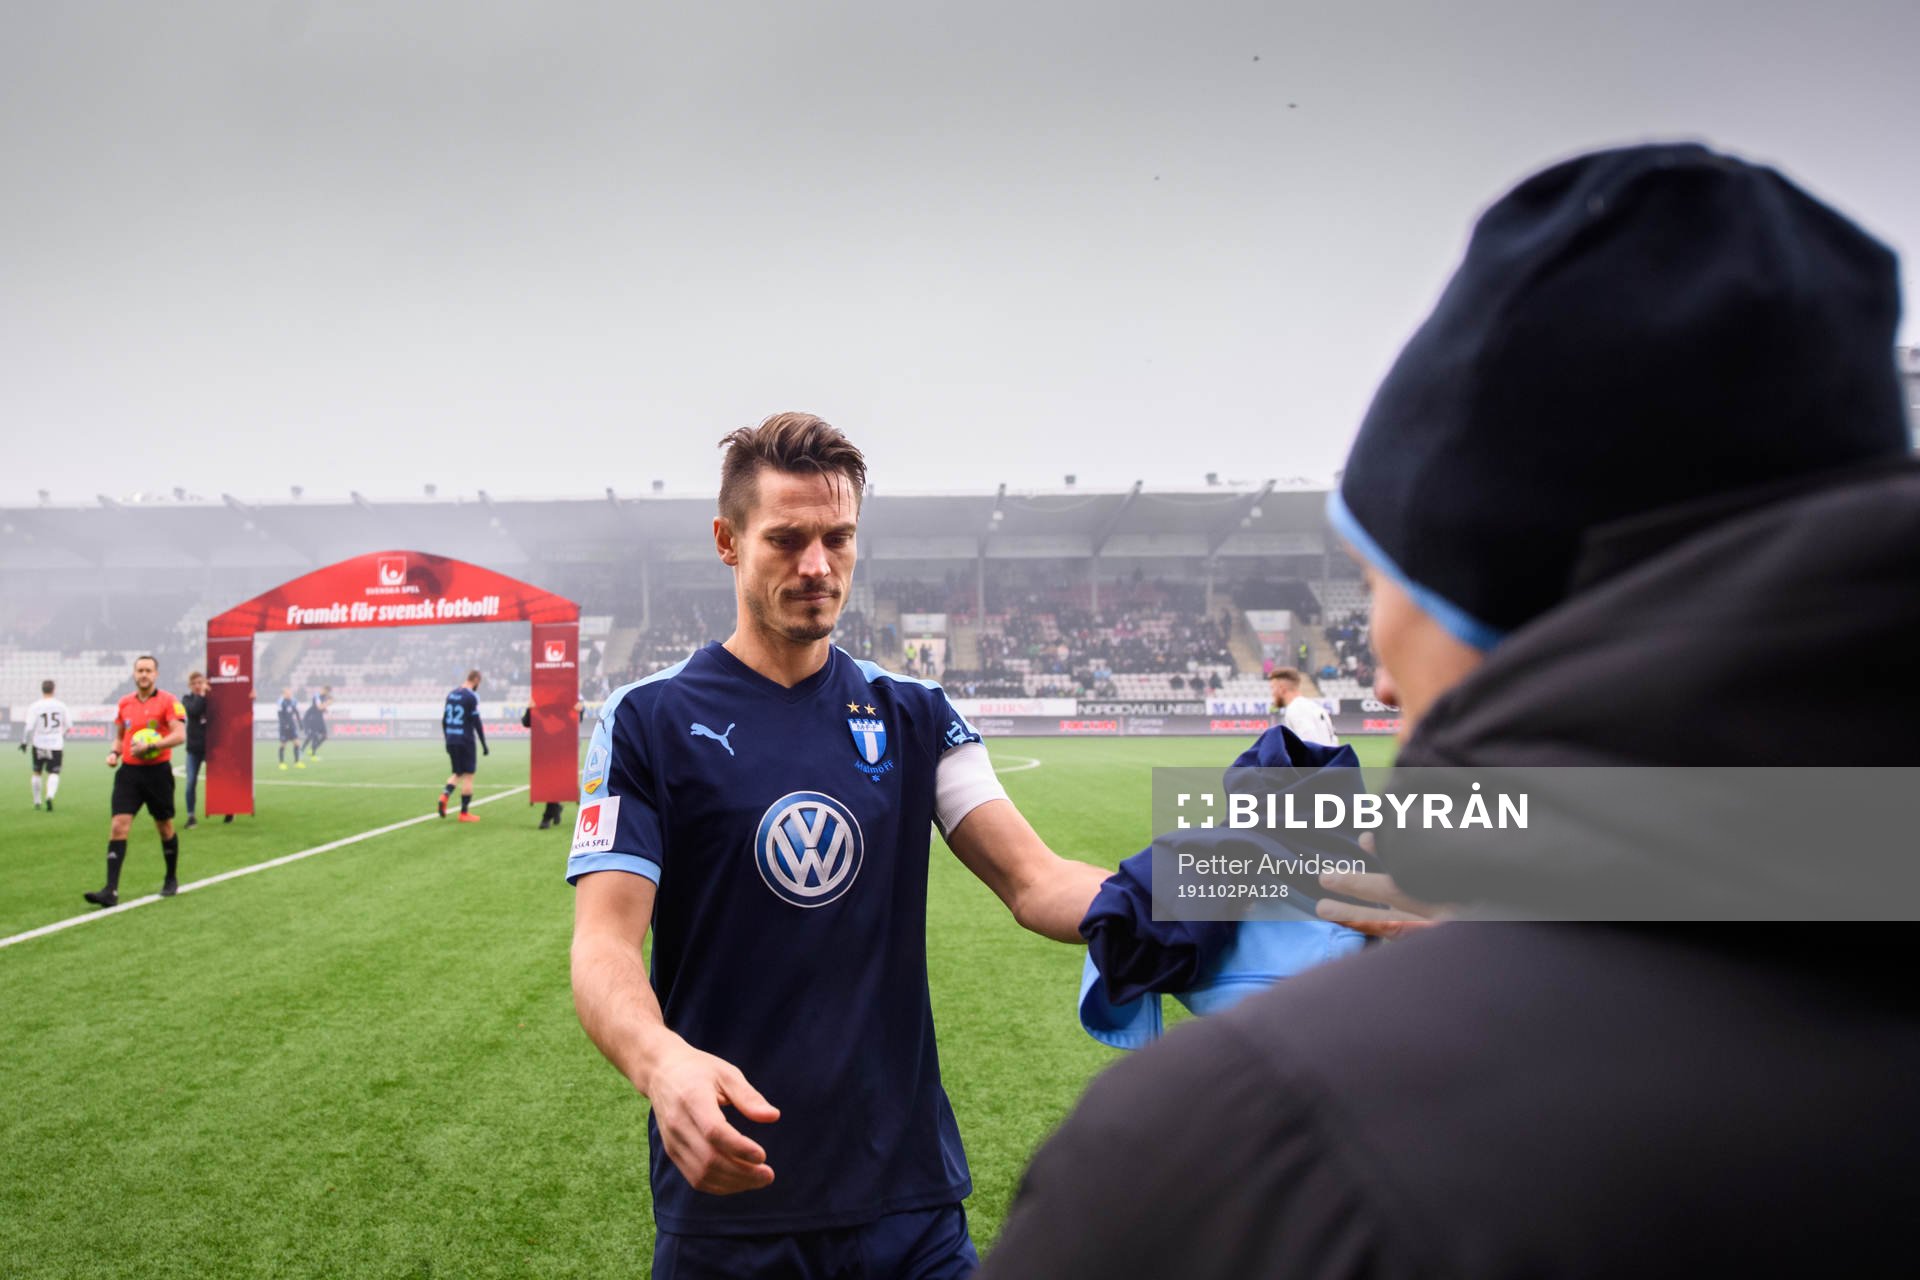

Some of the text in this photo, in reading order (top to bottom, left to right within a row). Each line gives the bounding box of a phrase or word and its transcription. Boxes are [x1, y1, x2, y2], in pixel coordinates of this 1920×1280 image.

[287, 596, 500, 625] Framåt för svensk fotboll!
[40, 712, 61, 728] 15
[446, 704, 465, 725] 32
[854, 760, 885, 774] Malmö
[592, 838, 609, 847] SPEL
